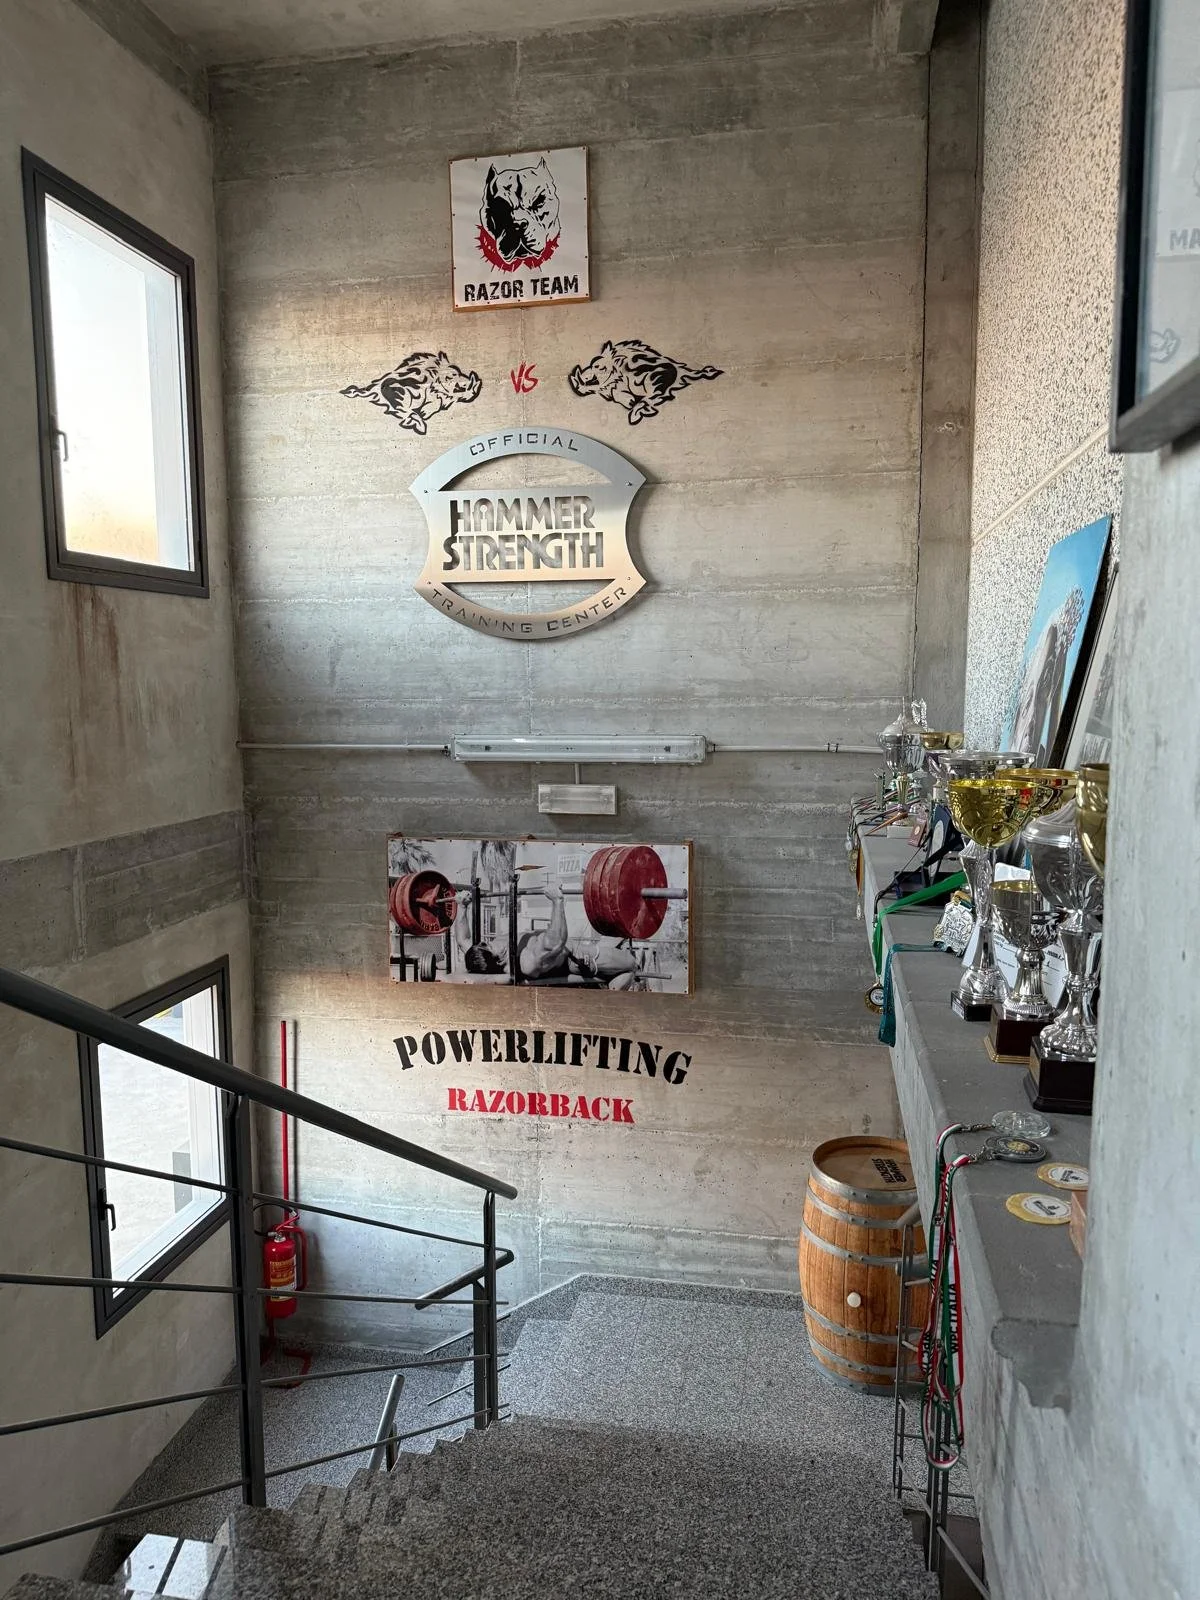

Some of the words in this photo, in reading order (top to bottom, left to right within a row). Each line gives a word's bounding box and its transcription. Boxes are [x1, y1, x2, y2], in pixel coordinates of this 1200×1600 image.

[464, 279, 524, 302] RAZOR
[530, 275, 579, 296] TEAM
[510, 362, 539, 394] VS
[469, 434, 579, 457] OFFICIAL
[449, 495, 596, 534] HAMMER
[442, 531, 605, 571] STRENGTH
[430, 588, 534, 634] TRAINING
[546, 585, 628, 632] CENTER
[558, 859, 581, 873] PIZZA
[393, 1029, 693, 1085] POWERLIFTING
[447, 1087, 635, 1124] RAZORBACK
